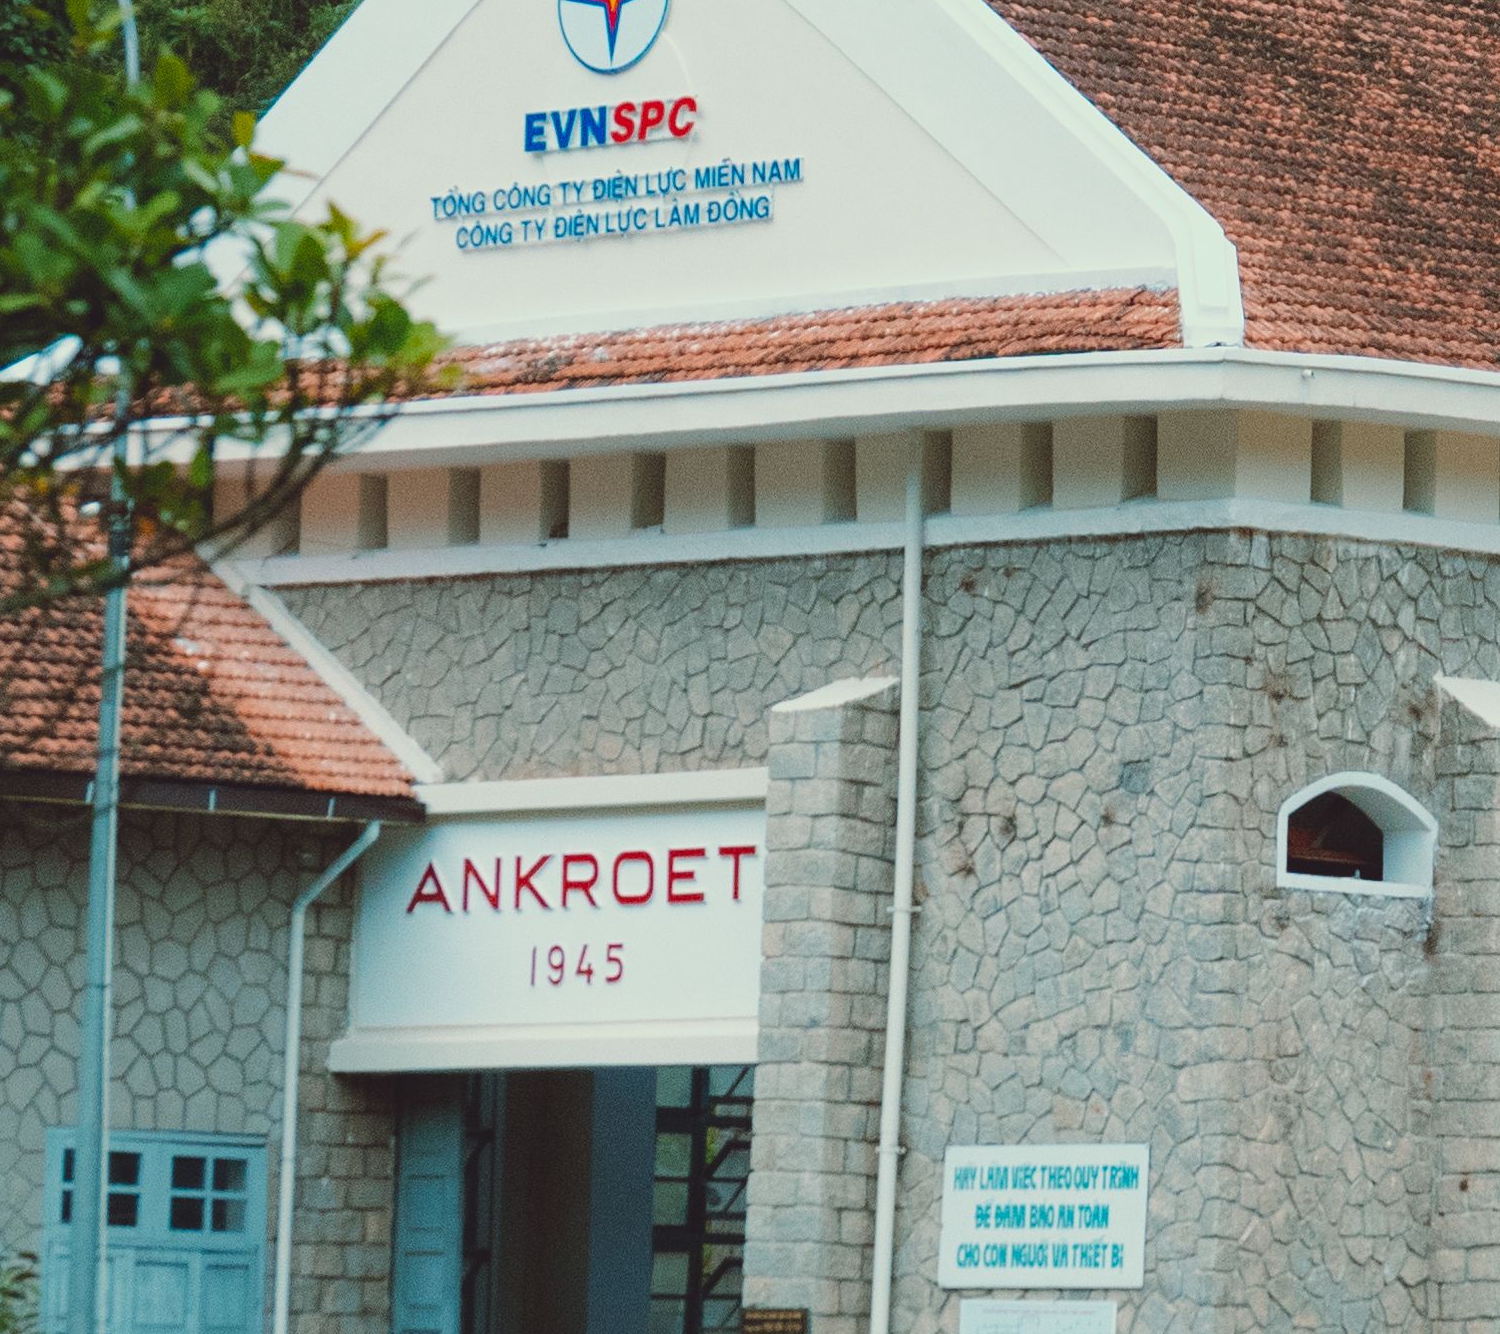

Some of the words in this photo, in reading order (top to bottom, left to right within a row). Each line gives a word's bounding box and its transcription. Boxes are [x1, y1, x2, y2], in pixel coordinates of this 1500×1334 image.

[525, 96, 697, 152] EVNSPC
[494, 182, 550, 210] CÔNG
[559, 181, 584, 204] TY
[593, 169, 637, 203] ĐIỆN
[646, 166, 686, 198] LỰC
[752, 158, 800, 183] NAM
[456, 220, 512, 249] CÔNG
[522, 219, 546, 242] TY
[555, 209, 599, 242] ĐIỆN
[606, 206, 646, 236] LỰC
[655, 198, 699, 228] LÂM
[707, 189, 770, 223] ĐỒNG
[406, 845, 757, 914] ANKROET
[530, 943, 625, 987] 1945
[956, 1243, 980, 1269] CHO
